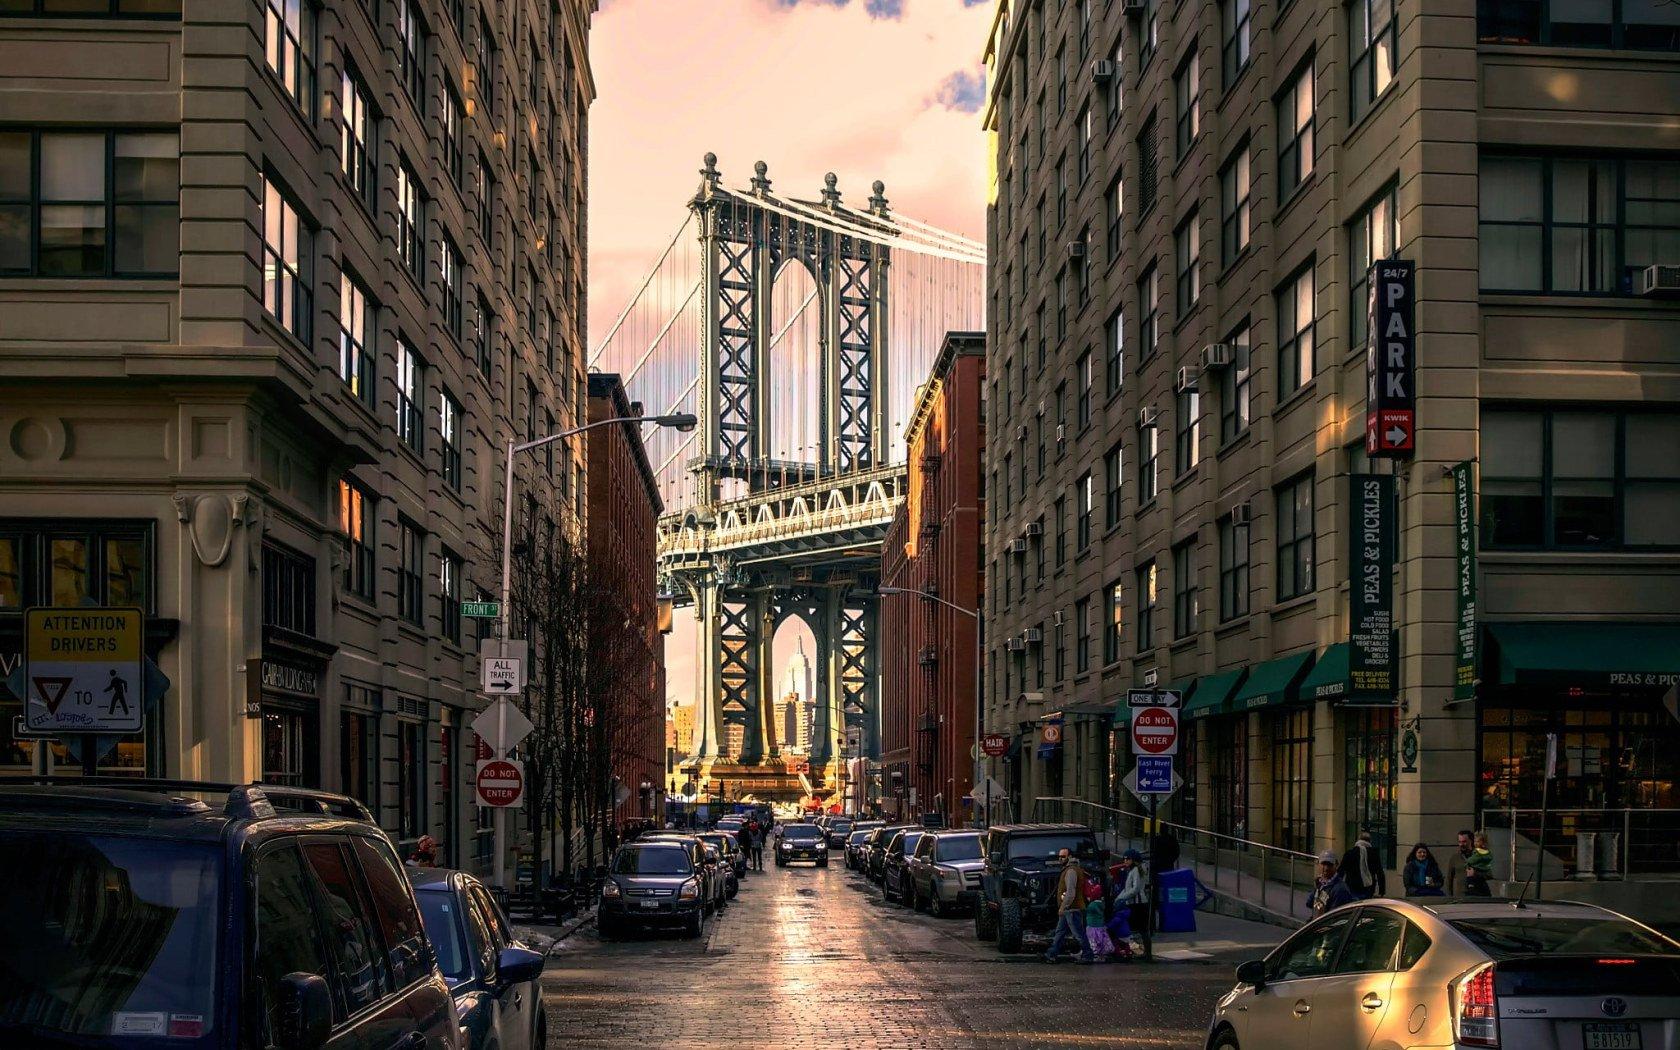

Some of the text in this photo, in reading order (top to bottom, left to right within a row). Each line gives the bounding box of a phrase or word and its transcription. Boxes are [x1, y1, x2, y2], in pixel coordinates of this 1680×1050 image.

[1383, 268, 1408, 278] 24/7
[1386, 283, 1407, 398] PARK
[1458, 468, 1469, 535] PICKLES
[1364, 480, 1380, 604] PEAS & PICKLES
[1462, 555, 1470, 597] PEAS
[463, 603, 488, 615] FRONT
[43, 616, 126, 631] ATTENTION
[51, 637, 117, 651] DRIVERS
[494, 661, 511, 669] ALL
[490, 671, 515, 679] TRAFFIC
[1610, 673, 1680, 686] PEAS & PIC
[75, 691, 93, 705] TO
[1140, 716, 1171, 725] DO NOT
[986, 738, 1004, 747] HAIR
[1142, 736, 1168, 745] ENTER
[484, 769, 516, 778] DO NOT
[1145, 769, 1163, 777] Ferry
[486, 789, 513, 798] ENTER
